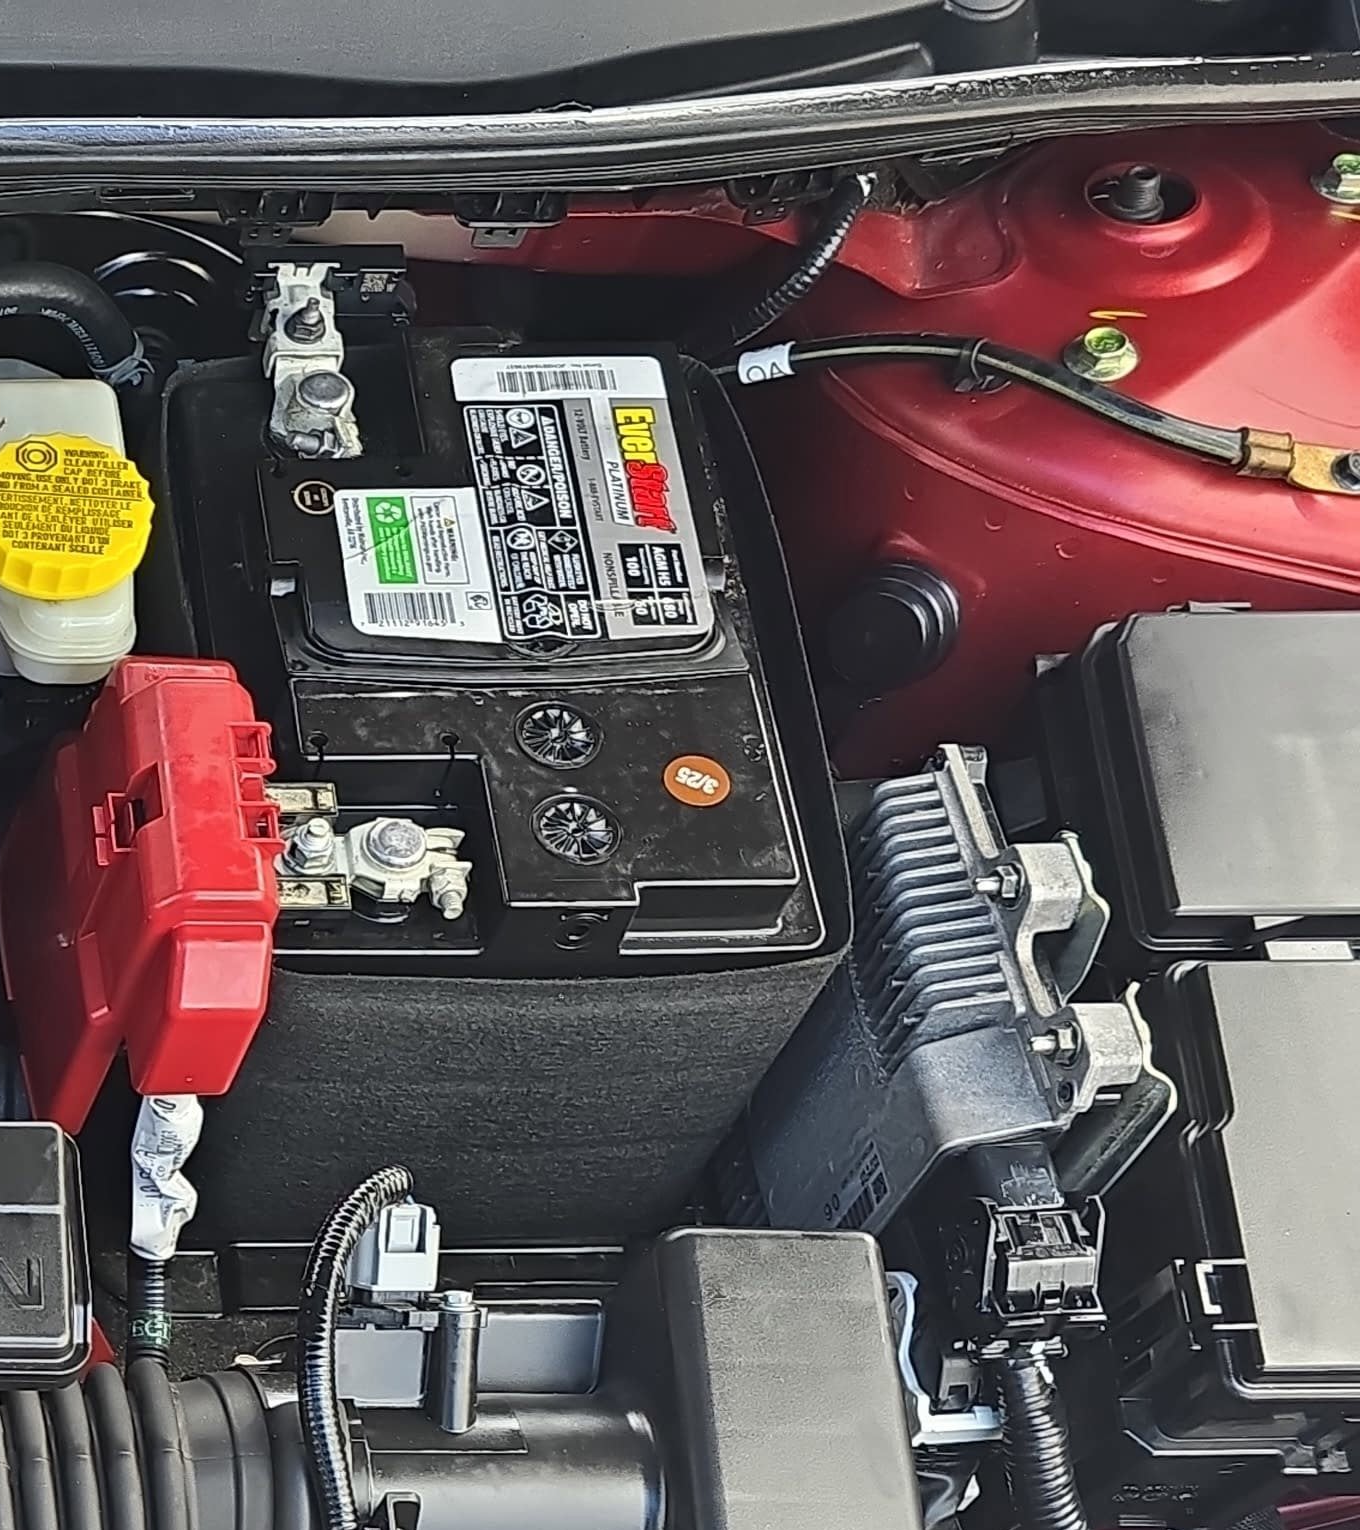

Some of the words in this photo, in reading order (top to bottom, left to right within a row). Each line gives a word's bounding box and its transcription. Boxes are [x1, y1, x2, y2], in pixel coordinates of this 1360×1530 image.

[573, 409, 589, 434] 12-VOLT
[578, 435, 591, 461] Battery
[544, 426, 572, 519] DANGER/POISON
[613, 407, 677, 531] EverStart
[14, 482, 39, 490] FROM
[607, 461, 630, 520] PLATINUM
[447, 527, 459, 562] WARNING:
[626, 556, 640, 576] 100
[652, 546, 668, 570] AGM
[658, 572, 673, 586] H5
[578, 600, 587, 612] DO
[581, 612, 592, 630] NOT
[674, 765, 720, 795] 3/25
